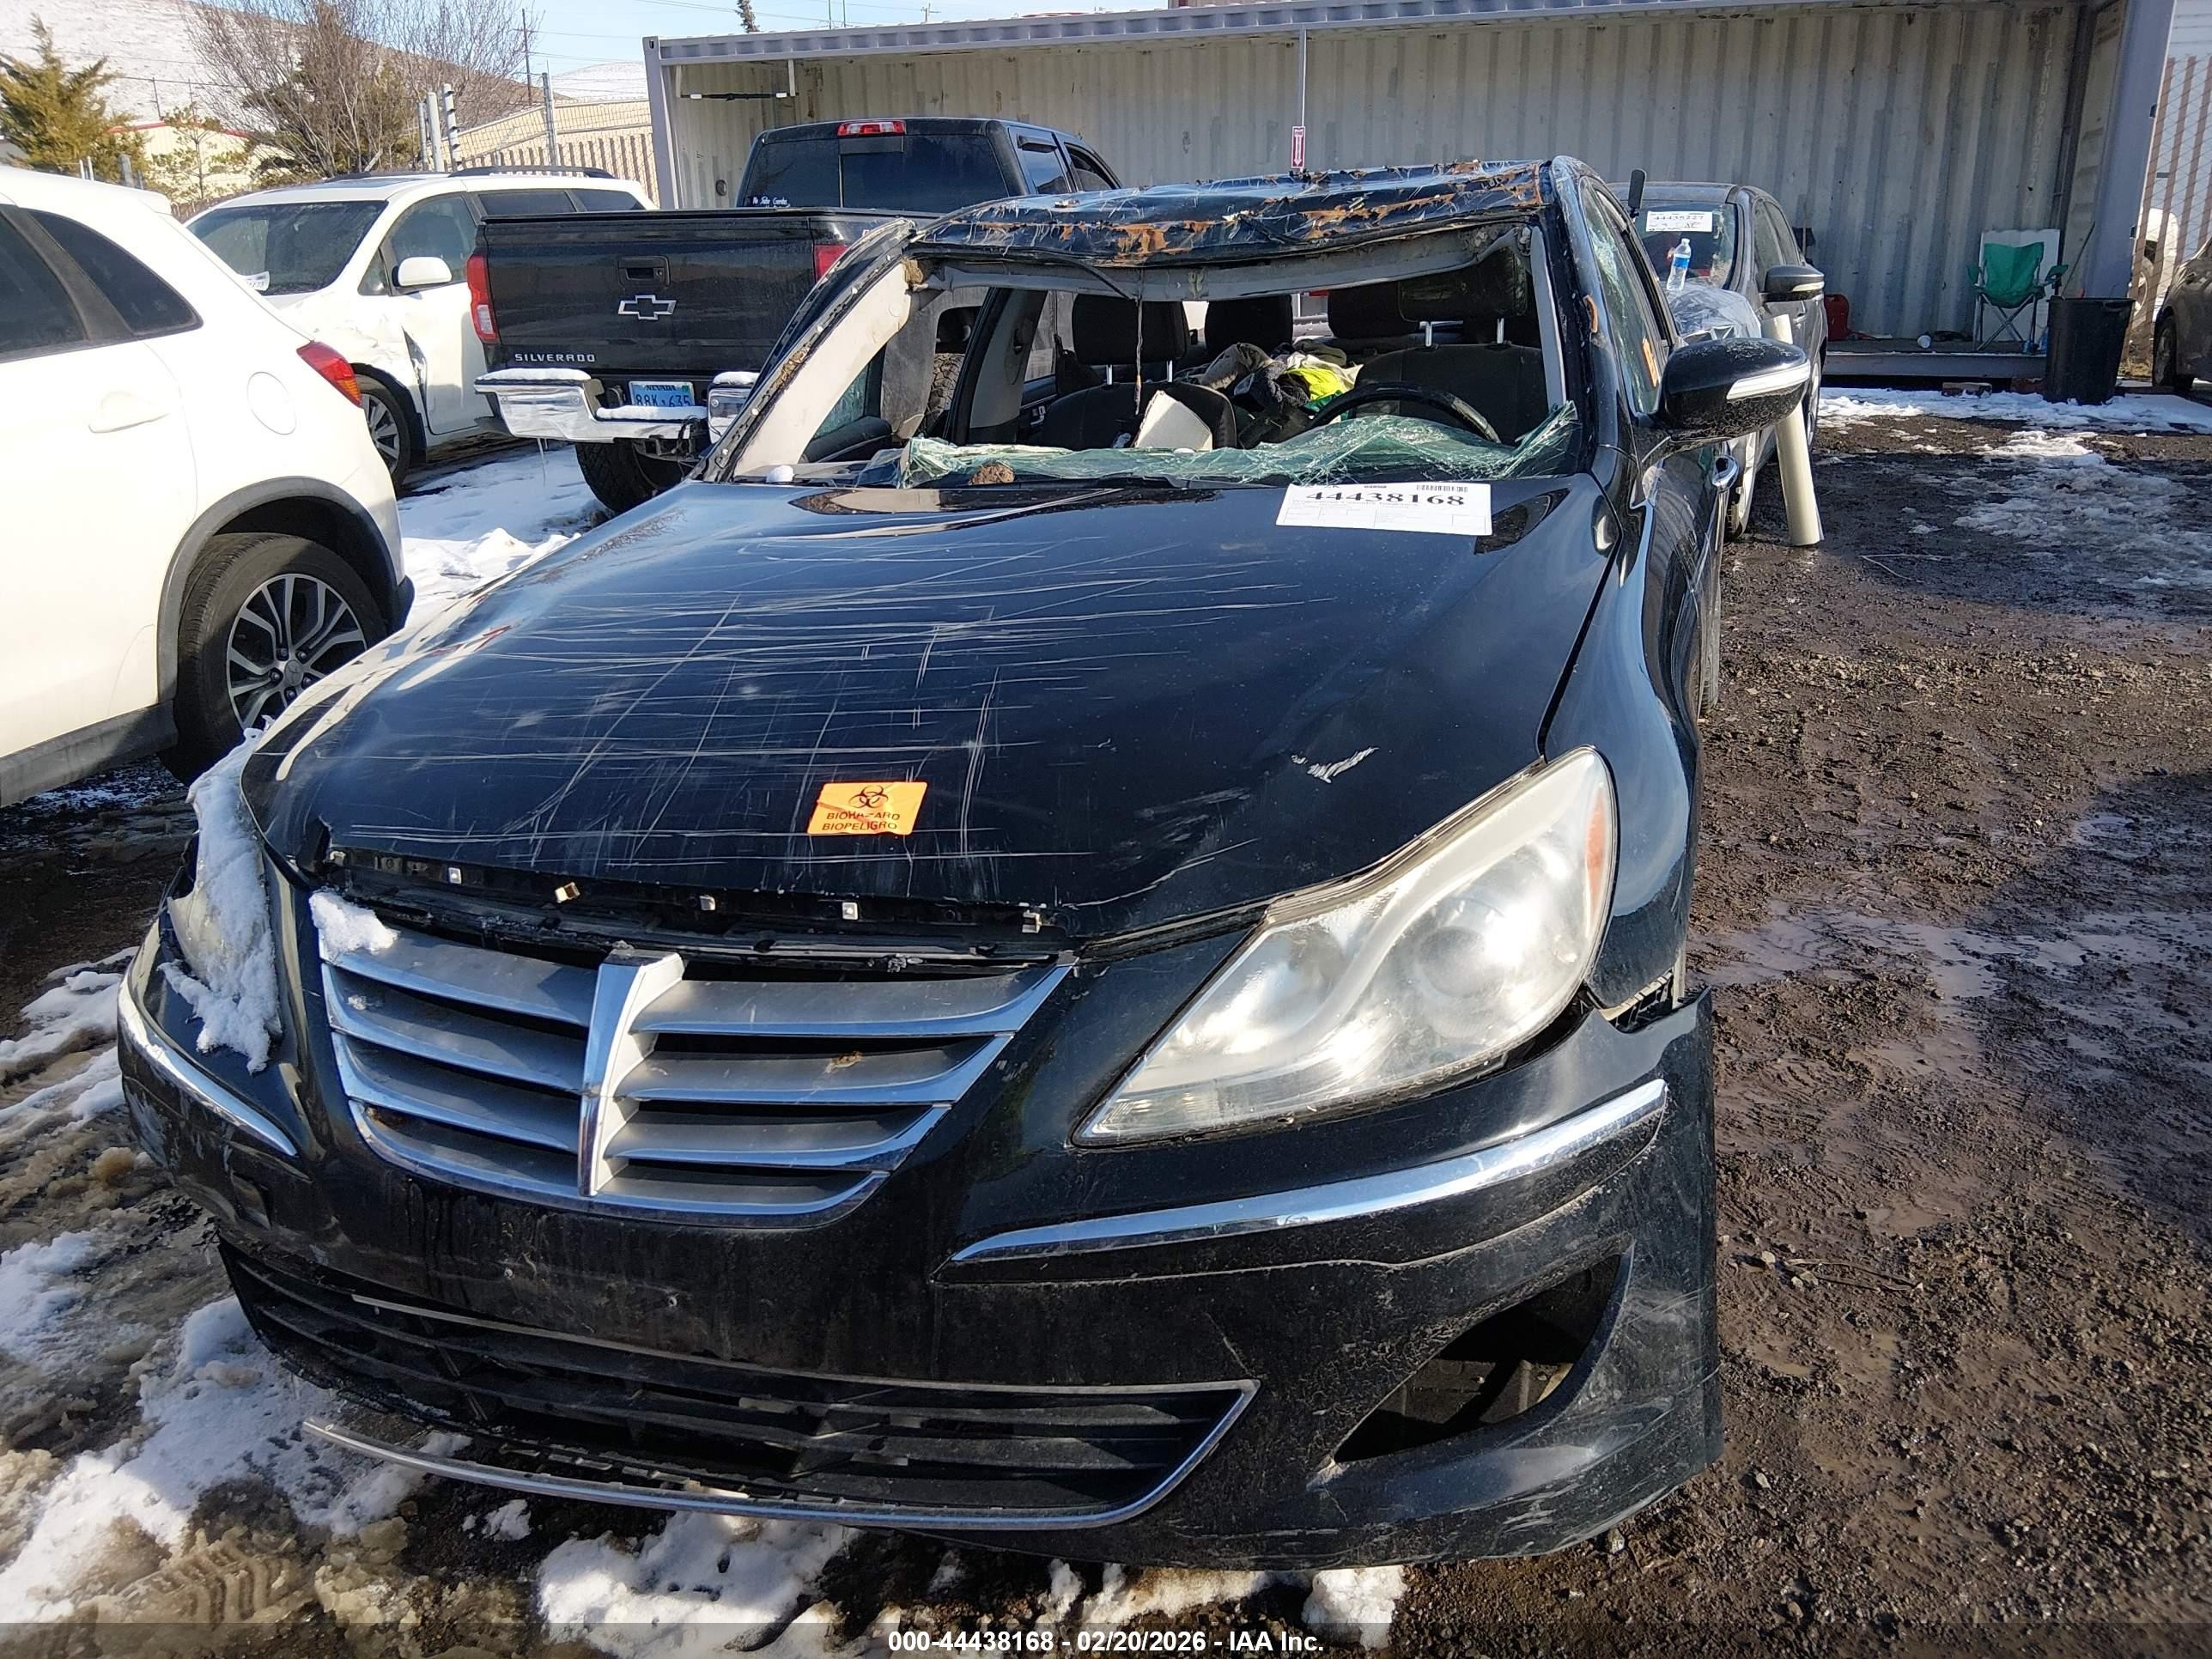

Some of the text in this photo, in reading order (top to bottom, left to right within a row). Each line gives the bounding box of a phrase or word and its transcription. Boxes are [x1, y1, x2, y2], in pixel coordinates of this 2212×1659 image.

[515, 353, 596, 362] SILVERADO
[1306, 490, 1465, 506] 44438168
[822, 820, 897, 831] BIOPELIGRO
